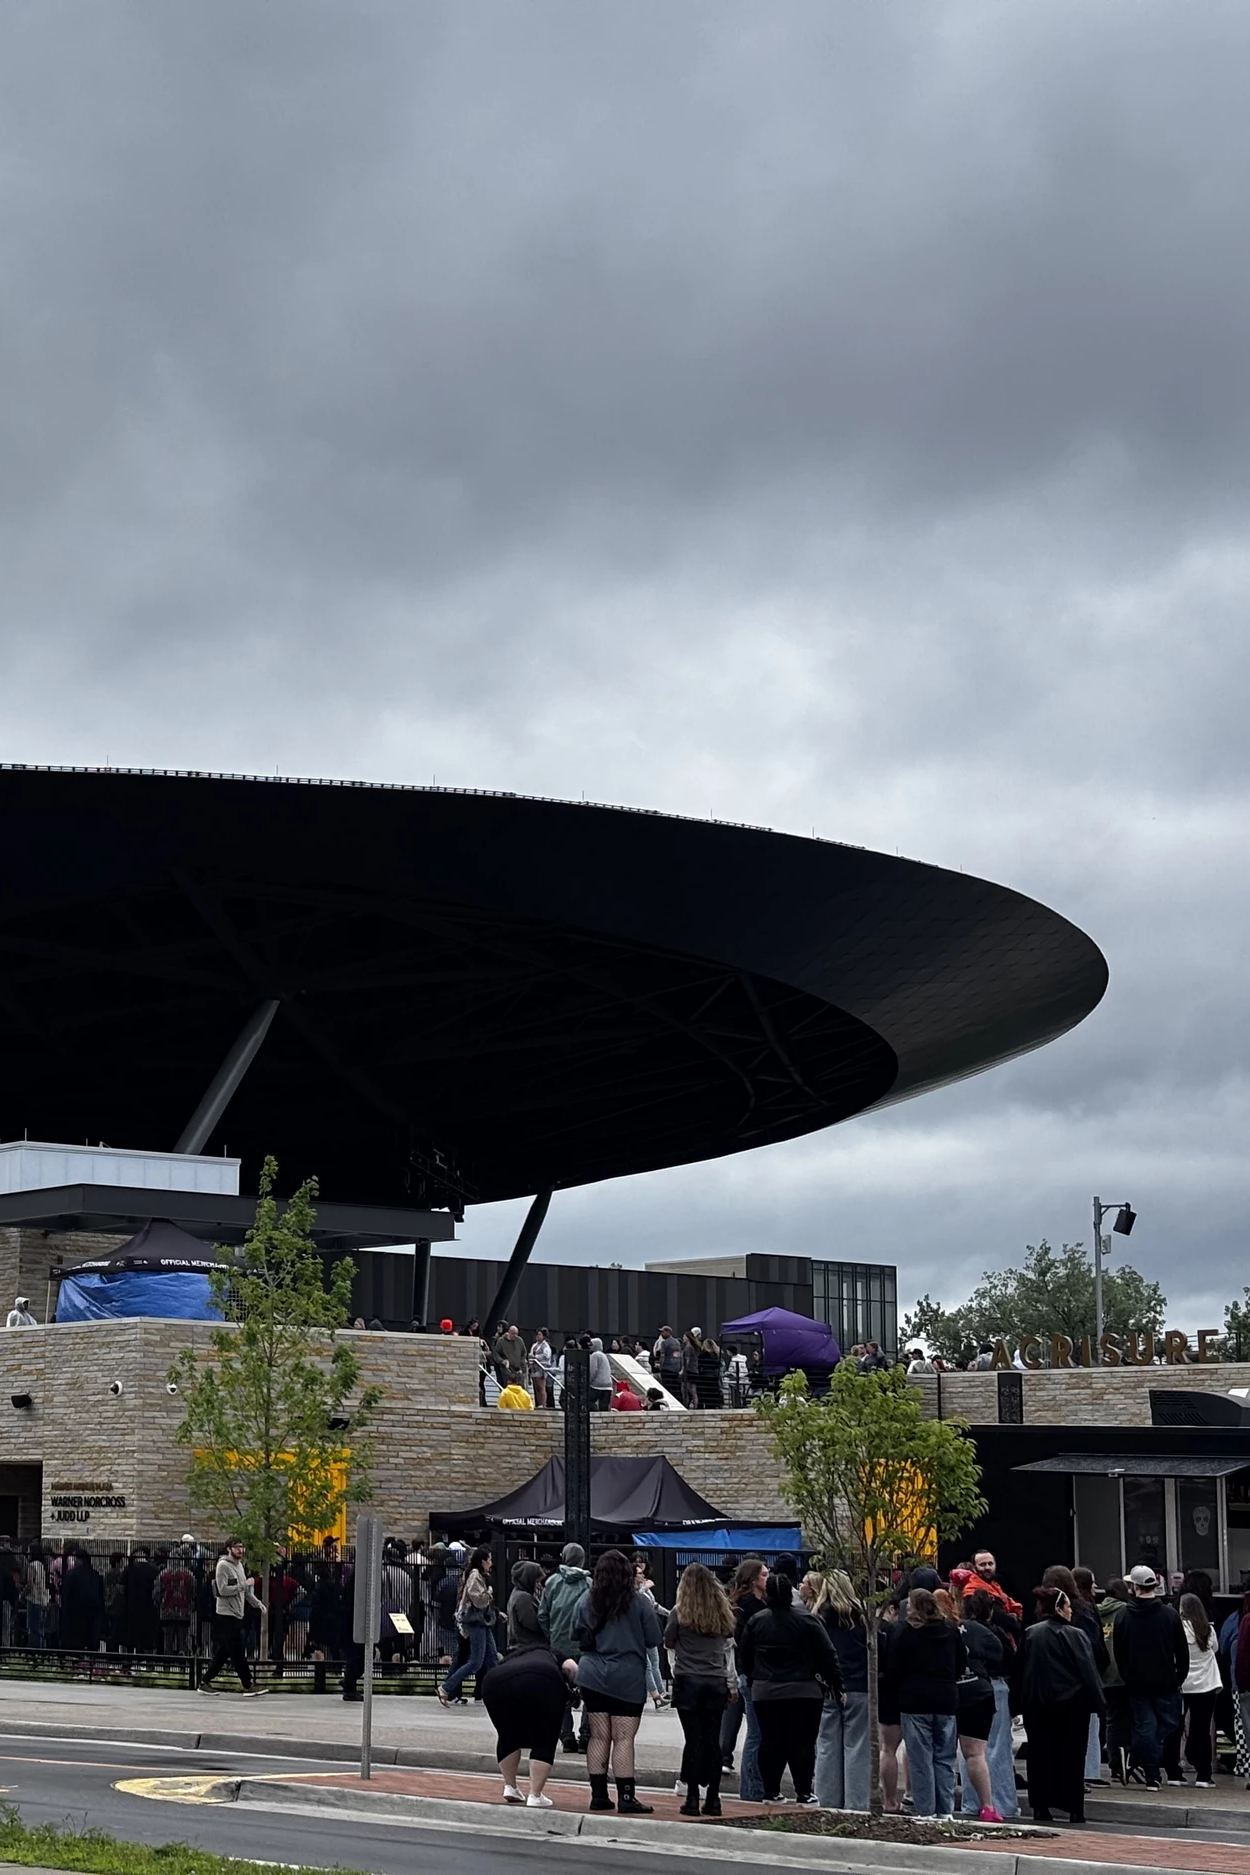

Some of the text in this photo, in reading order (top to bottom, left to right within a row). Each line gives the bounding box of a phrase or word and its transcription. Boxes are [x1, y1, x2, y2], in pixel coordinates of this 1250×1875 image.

[989, 1329, 1220, 1370] ACRISURE
[51, 1496, 126, 1508] WARNER NORCROSS
[56, 1510, 76, 1521] JUDD
[76, 1510, 90, 1522] LLP
